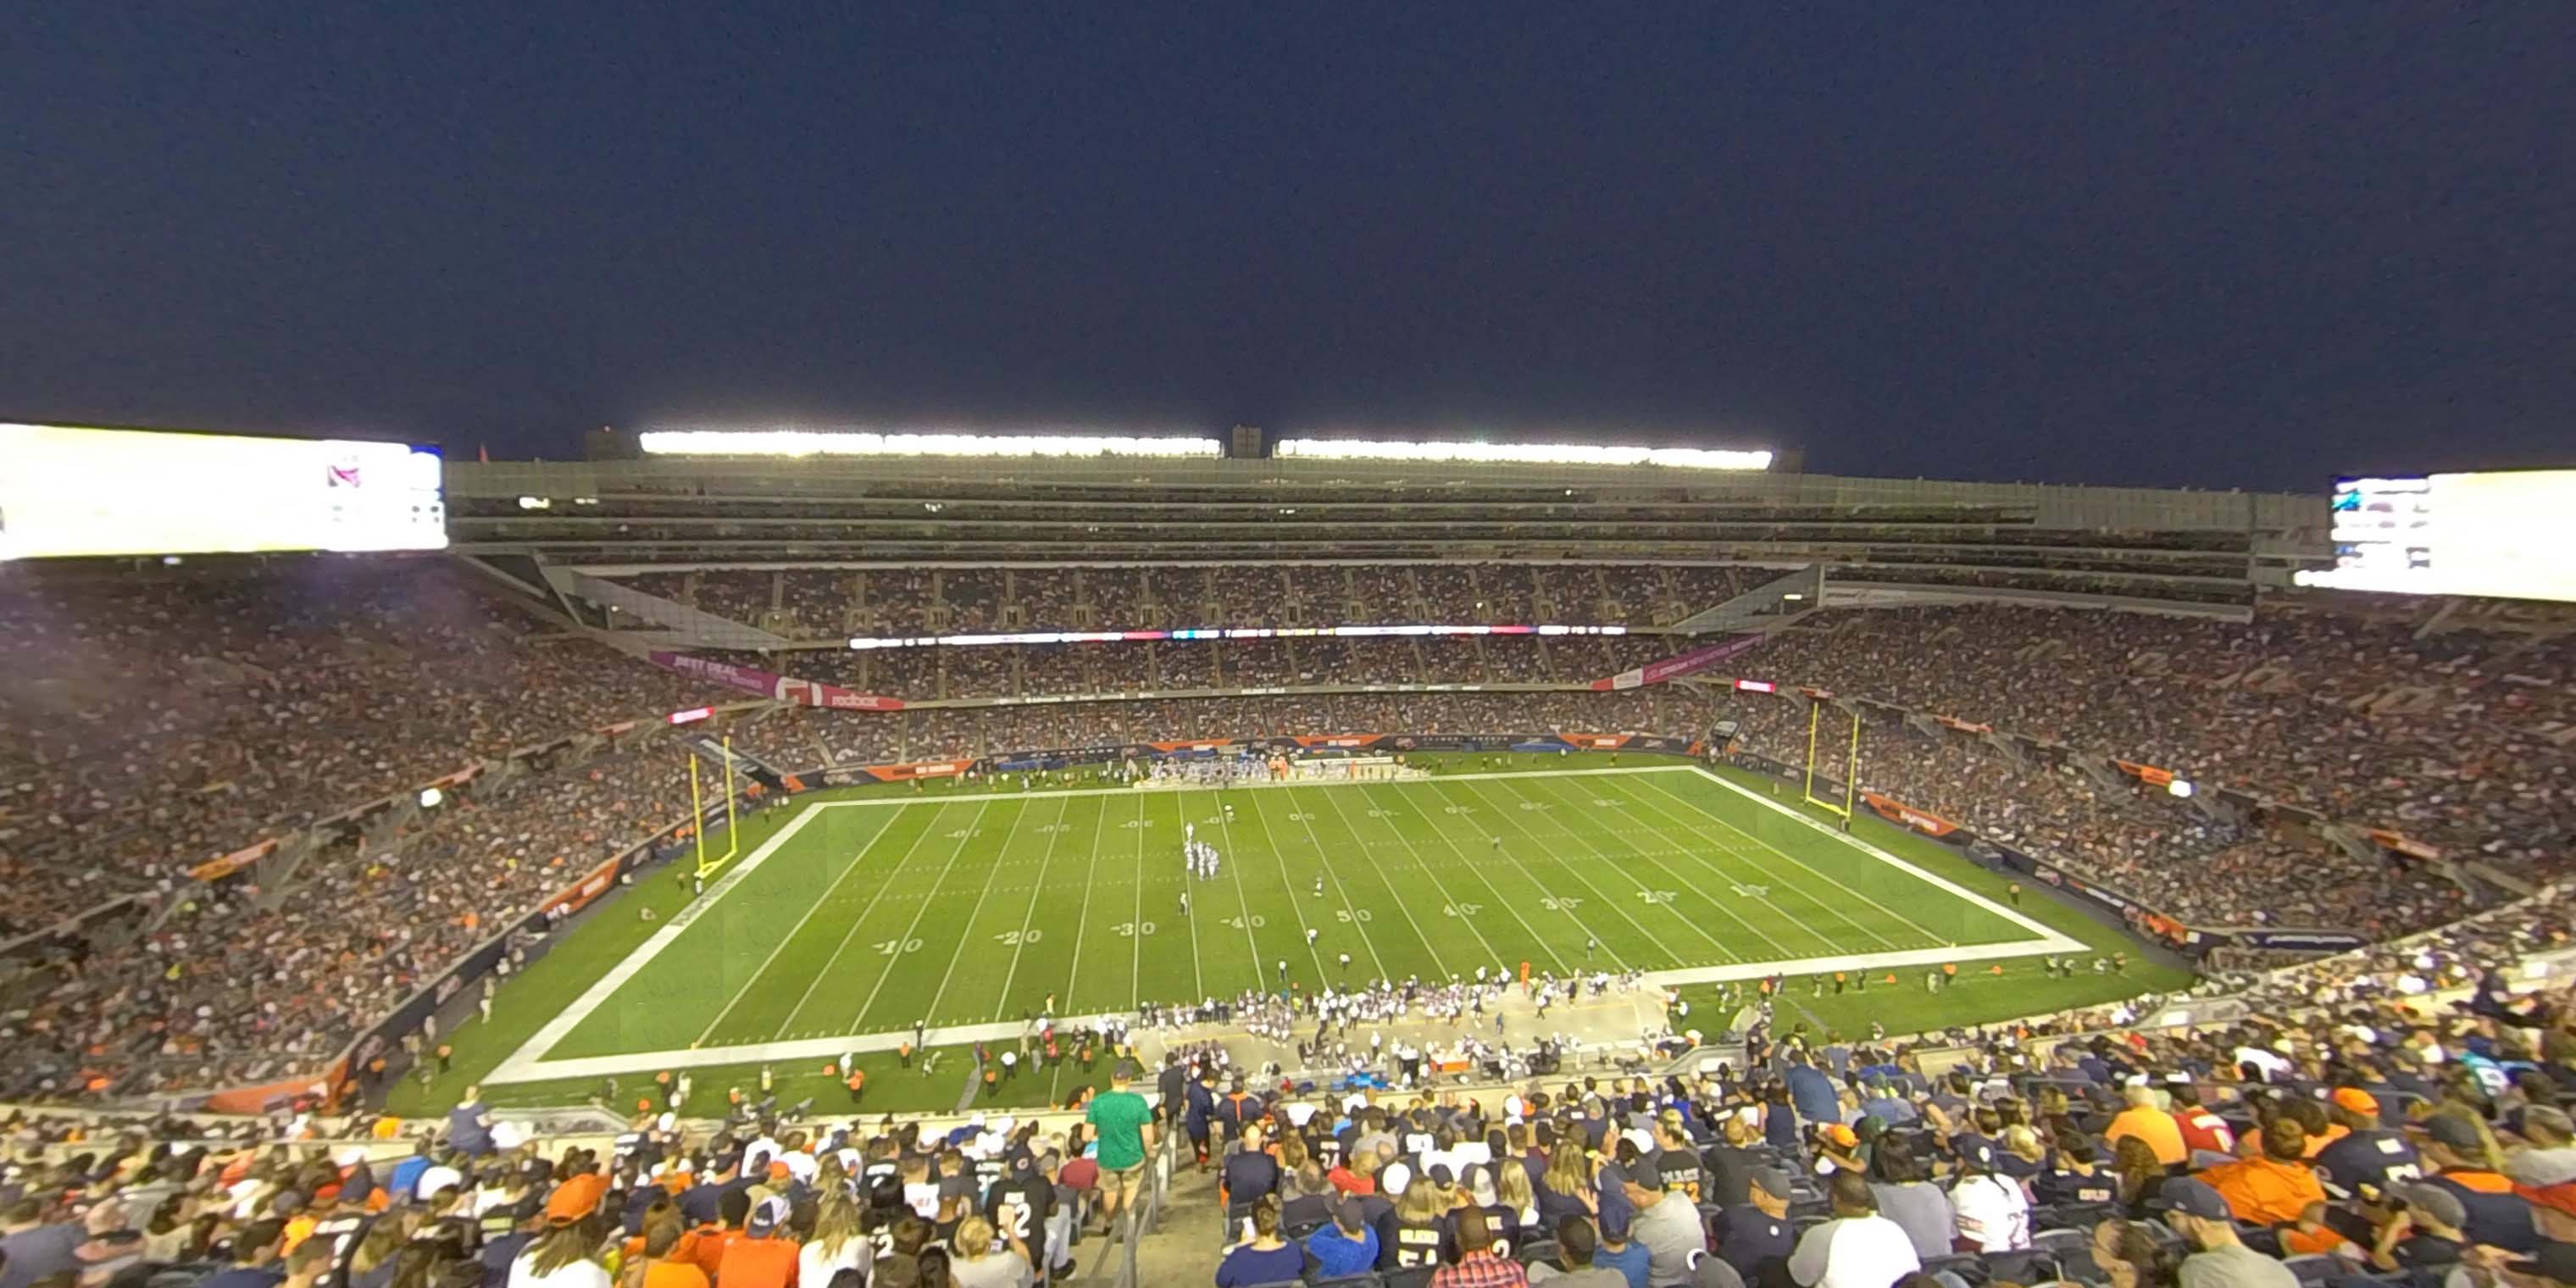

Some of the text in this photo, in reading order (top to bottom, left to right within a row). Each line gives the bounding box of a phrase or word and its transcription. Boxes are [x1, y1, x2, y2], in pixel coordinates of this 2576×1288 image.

[832, 693, 879, 707] redbox
[1541, 897, 1576, 911] 30
[1636, 891, 1673, 903] 20
[1336, 909, 1373, 923] 50
[1443, 902, 1478, 917] 40
[1119, 921, 1158, 935] 30
[1230, 915, 1265, 929] 40
[1002, 929, 1043, 945] 20
[879, 937, 924, 955] 10
